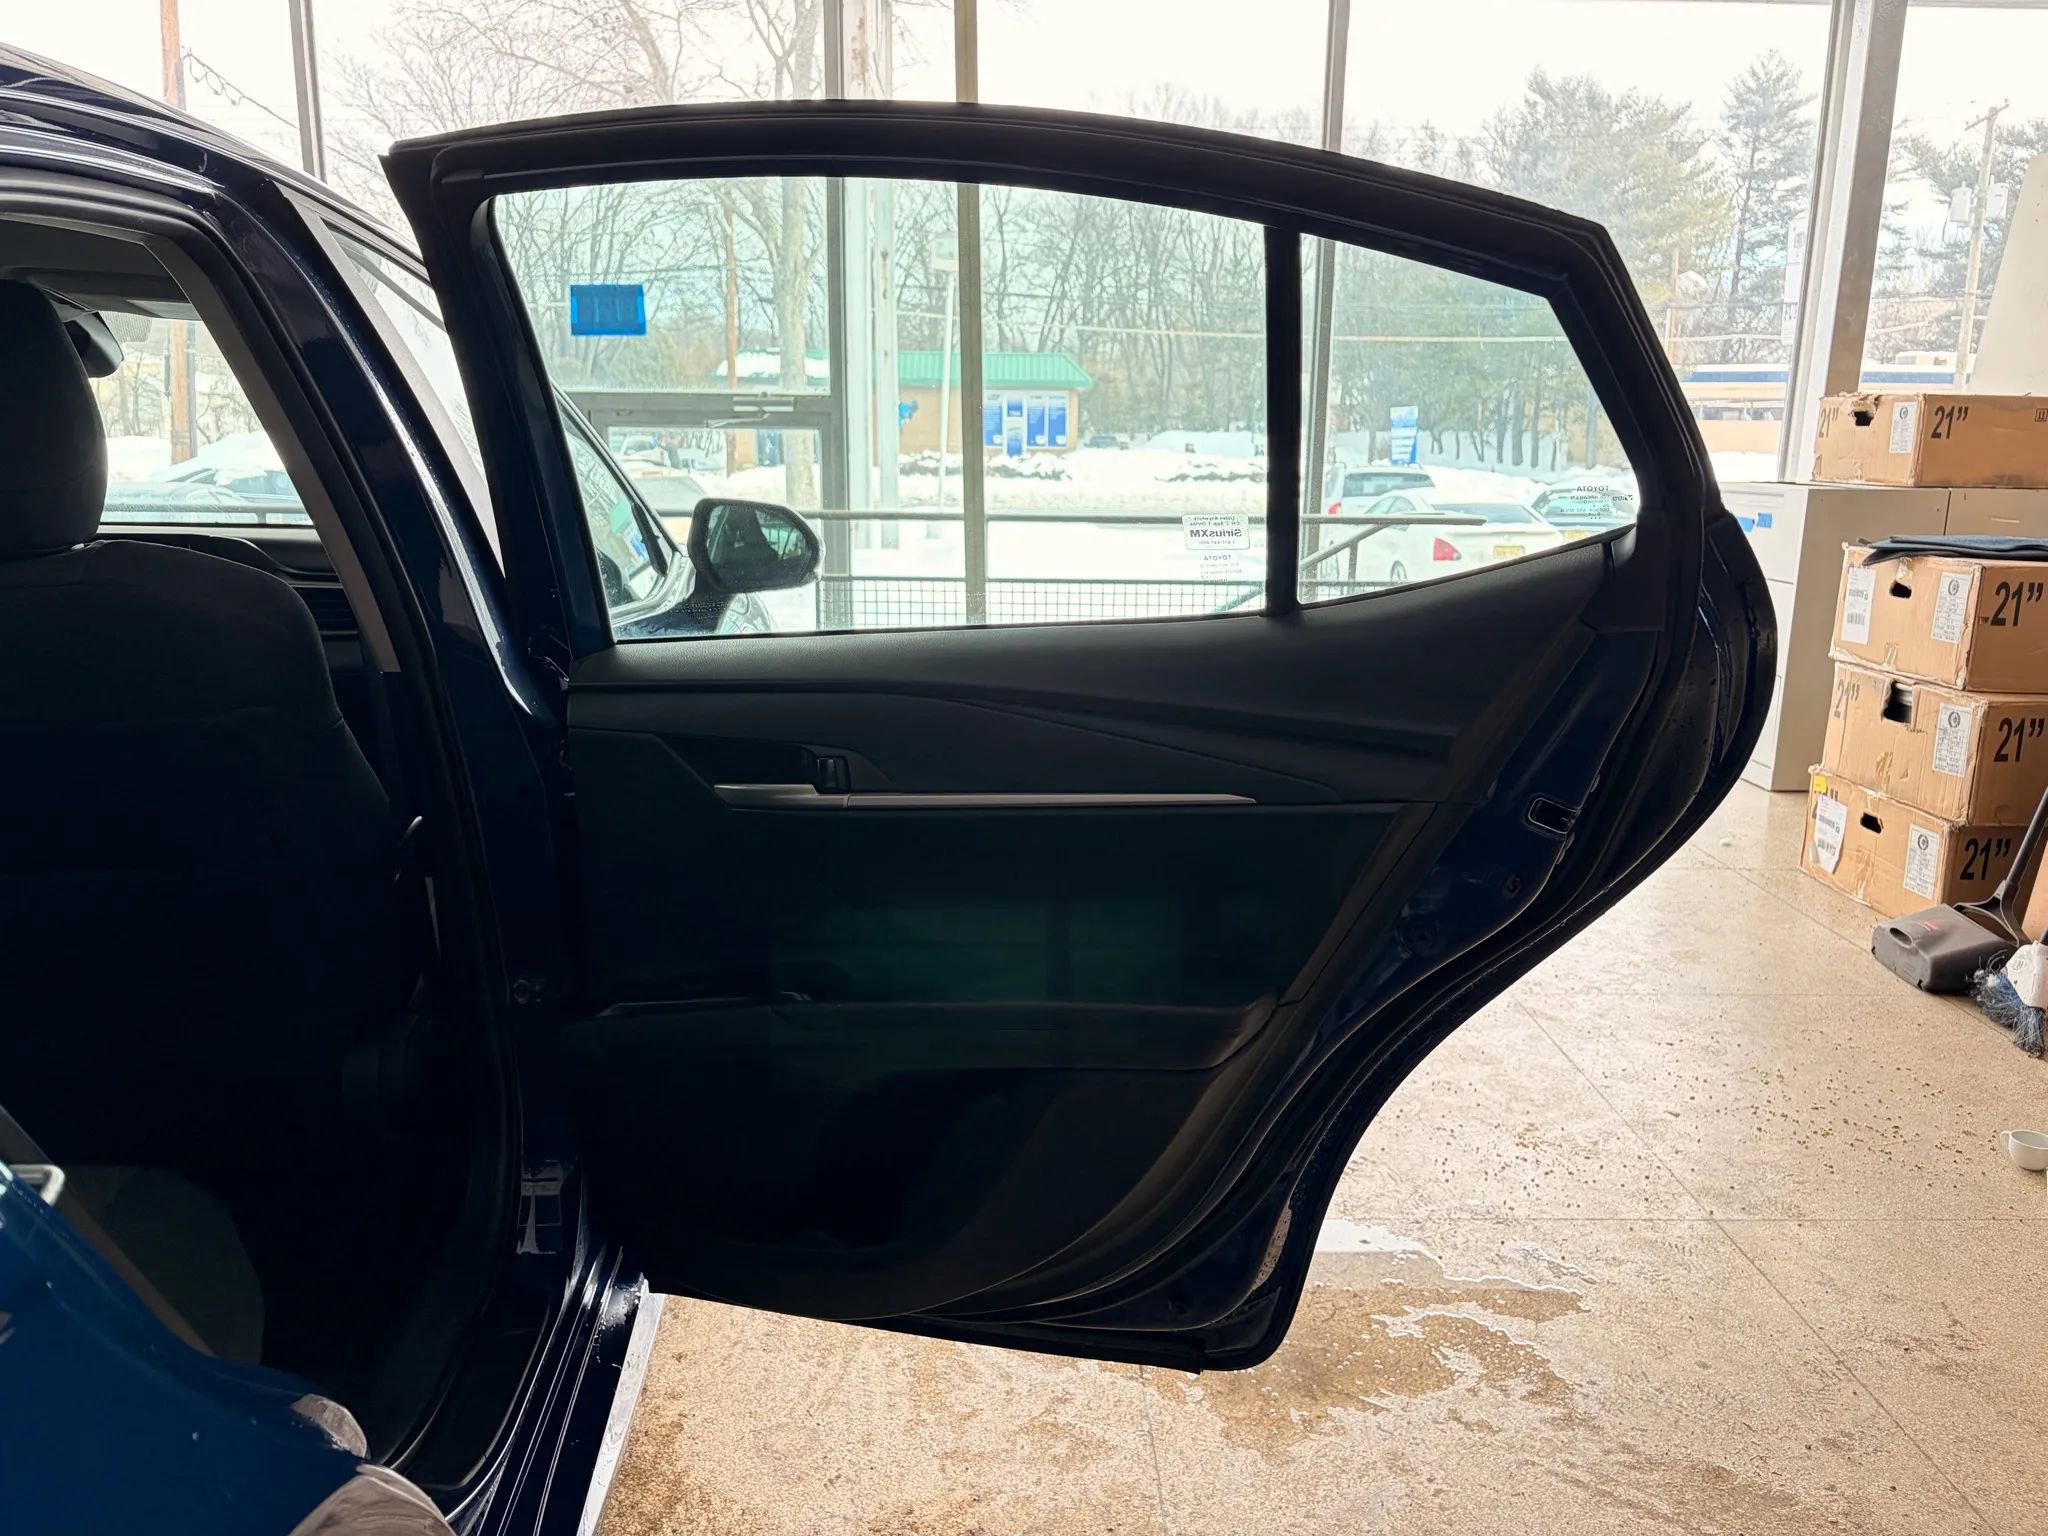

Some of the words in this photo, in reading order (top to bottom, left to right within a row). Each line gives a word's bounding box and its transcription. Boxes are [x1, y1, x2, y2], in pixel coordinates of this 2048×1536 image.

[1930, 405, 1969, 439] 21”
[1990, 581, 2044, 627] 21”
[1993, 717, 2045, 763] 21”
[1959, 837, 2011, 881] 21”
